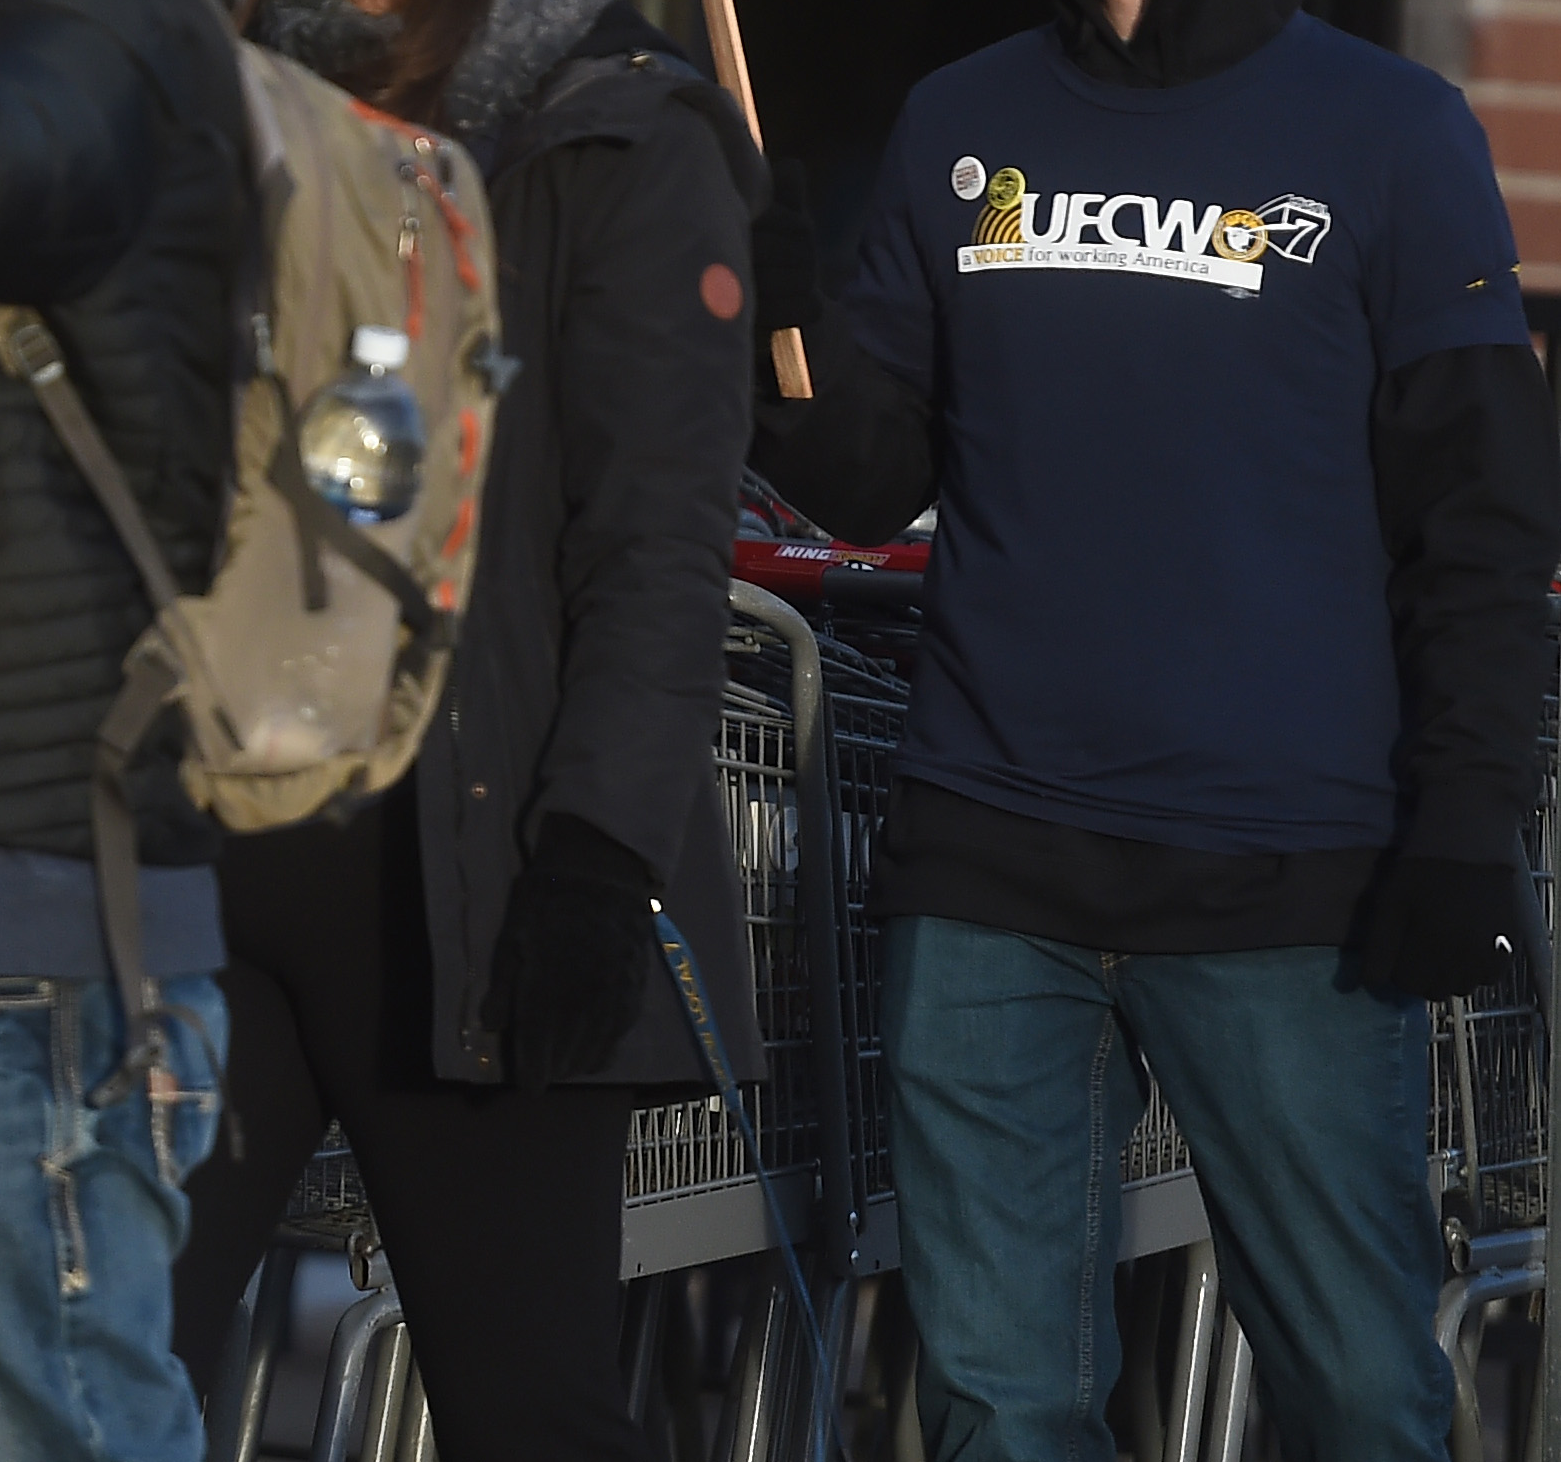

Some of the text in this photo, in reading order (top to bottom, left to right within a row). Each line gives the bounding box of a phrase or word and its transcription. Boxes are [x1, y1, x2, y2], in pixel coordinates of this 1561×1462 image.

[1020, 193, 1223, 256] UFCW
[962, 245, 1210, 275] a VOICE for working America
[780, 544, 833, 560] KING
